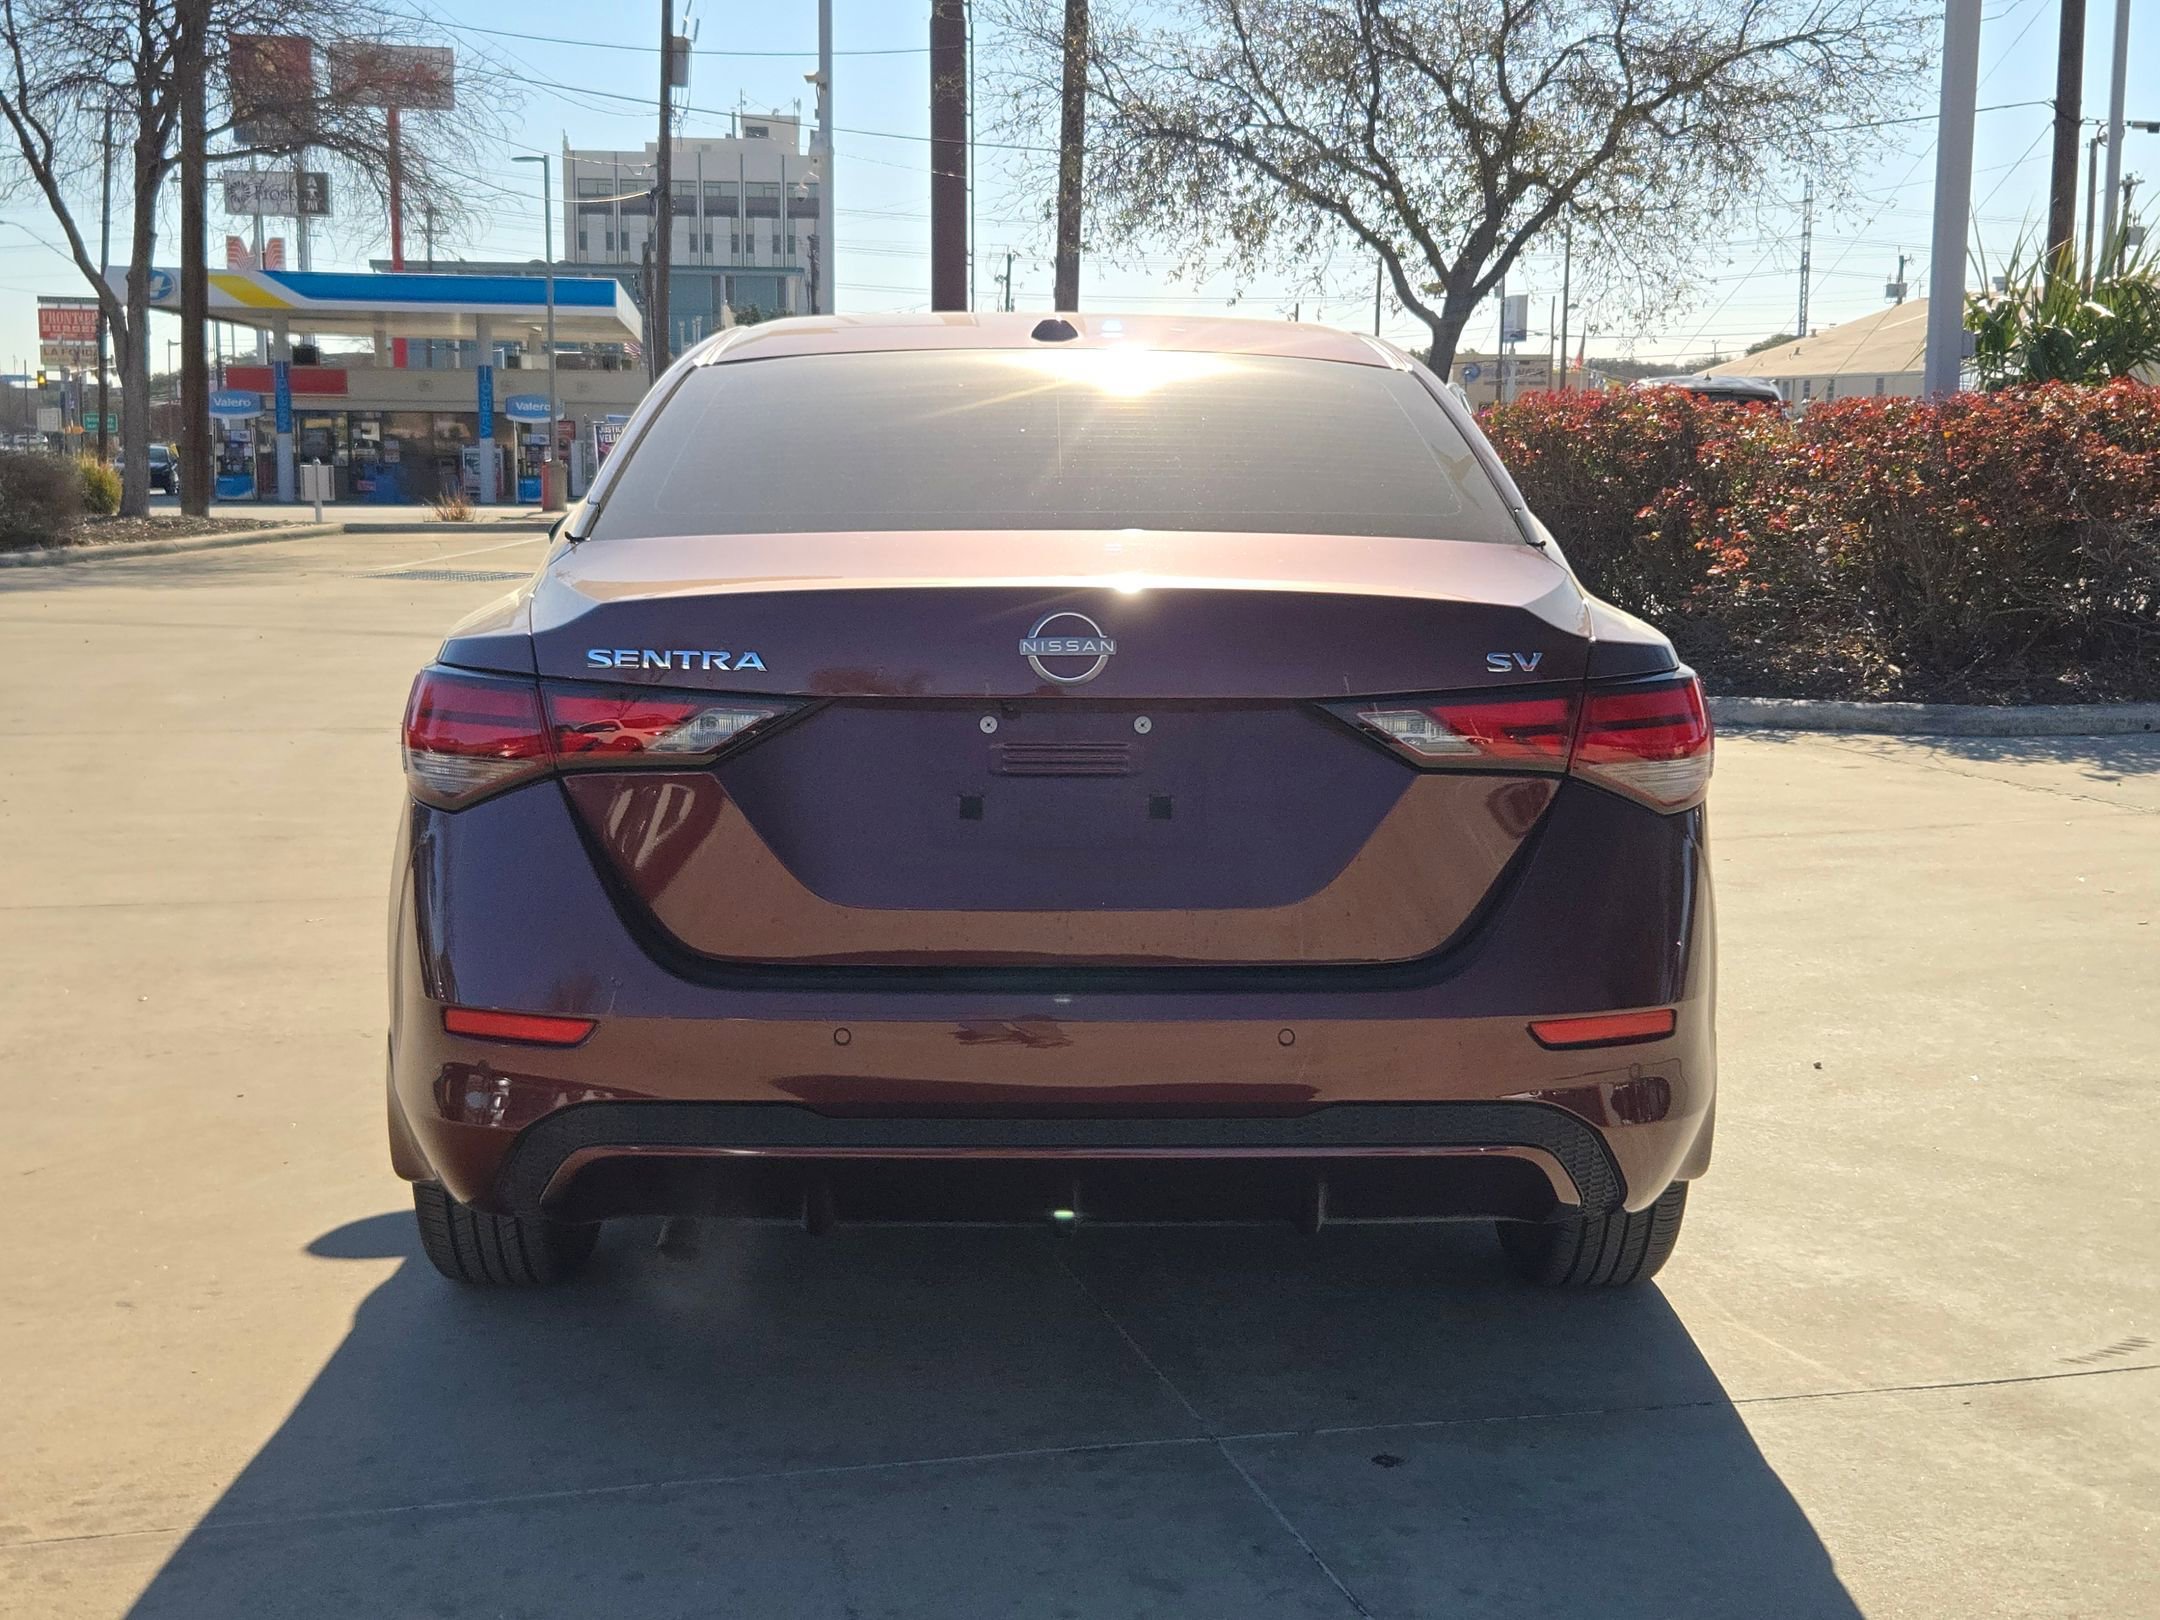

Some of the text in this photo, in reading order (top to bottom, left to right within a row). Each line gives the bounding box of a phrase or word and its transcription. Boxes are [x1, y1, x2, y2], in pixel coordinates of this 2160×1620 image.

[43, 347, 58, 356] LA
[213, 398, 252, 407] Valero
[1022, 640, 1114, 652] NISSAN
[587, 649, 767, 671] SENTRA
[1486, 652, 1543, 672] SV
